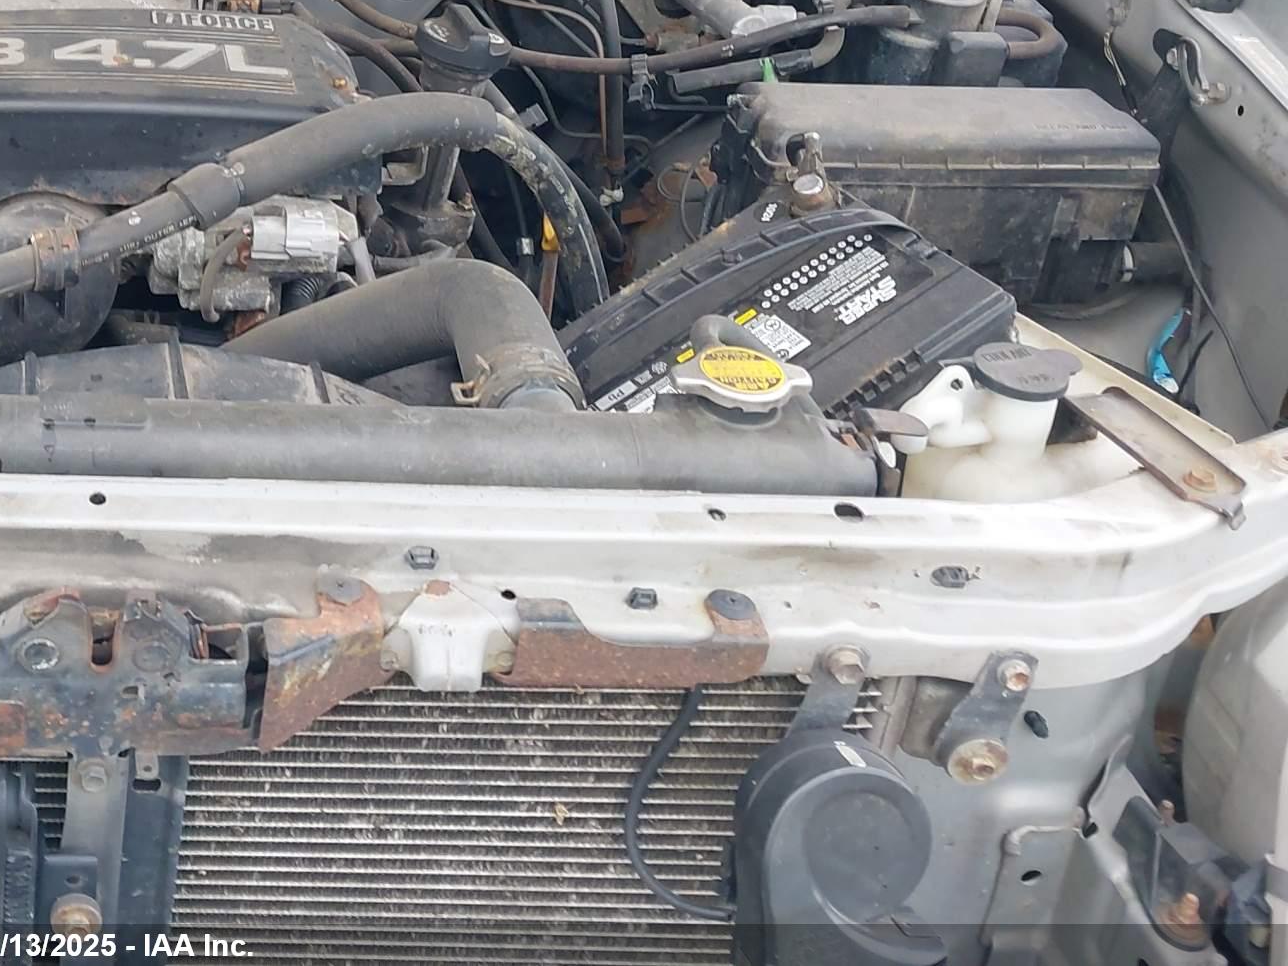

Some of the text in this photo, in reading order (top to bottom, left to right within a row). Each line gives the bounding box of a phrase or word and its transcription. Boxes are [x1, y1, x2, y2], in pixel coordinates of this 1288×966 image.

[53, 37, 290, 77] 4.7L
[837, 275, 896, 316] START
[842, 287, 897, 325] SUPER
